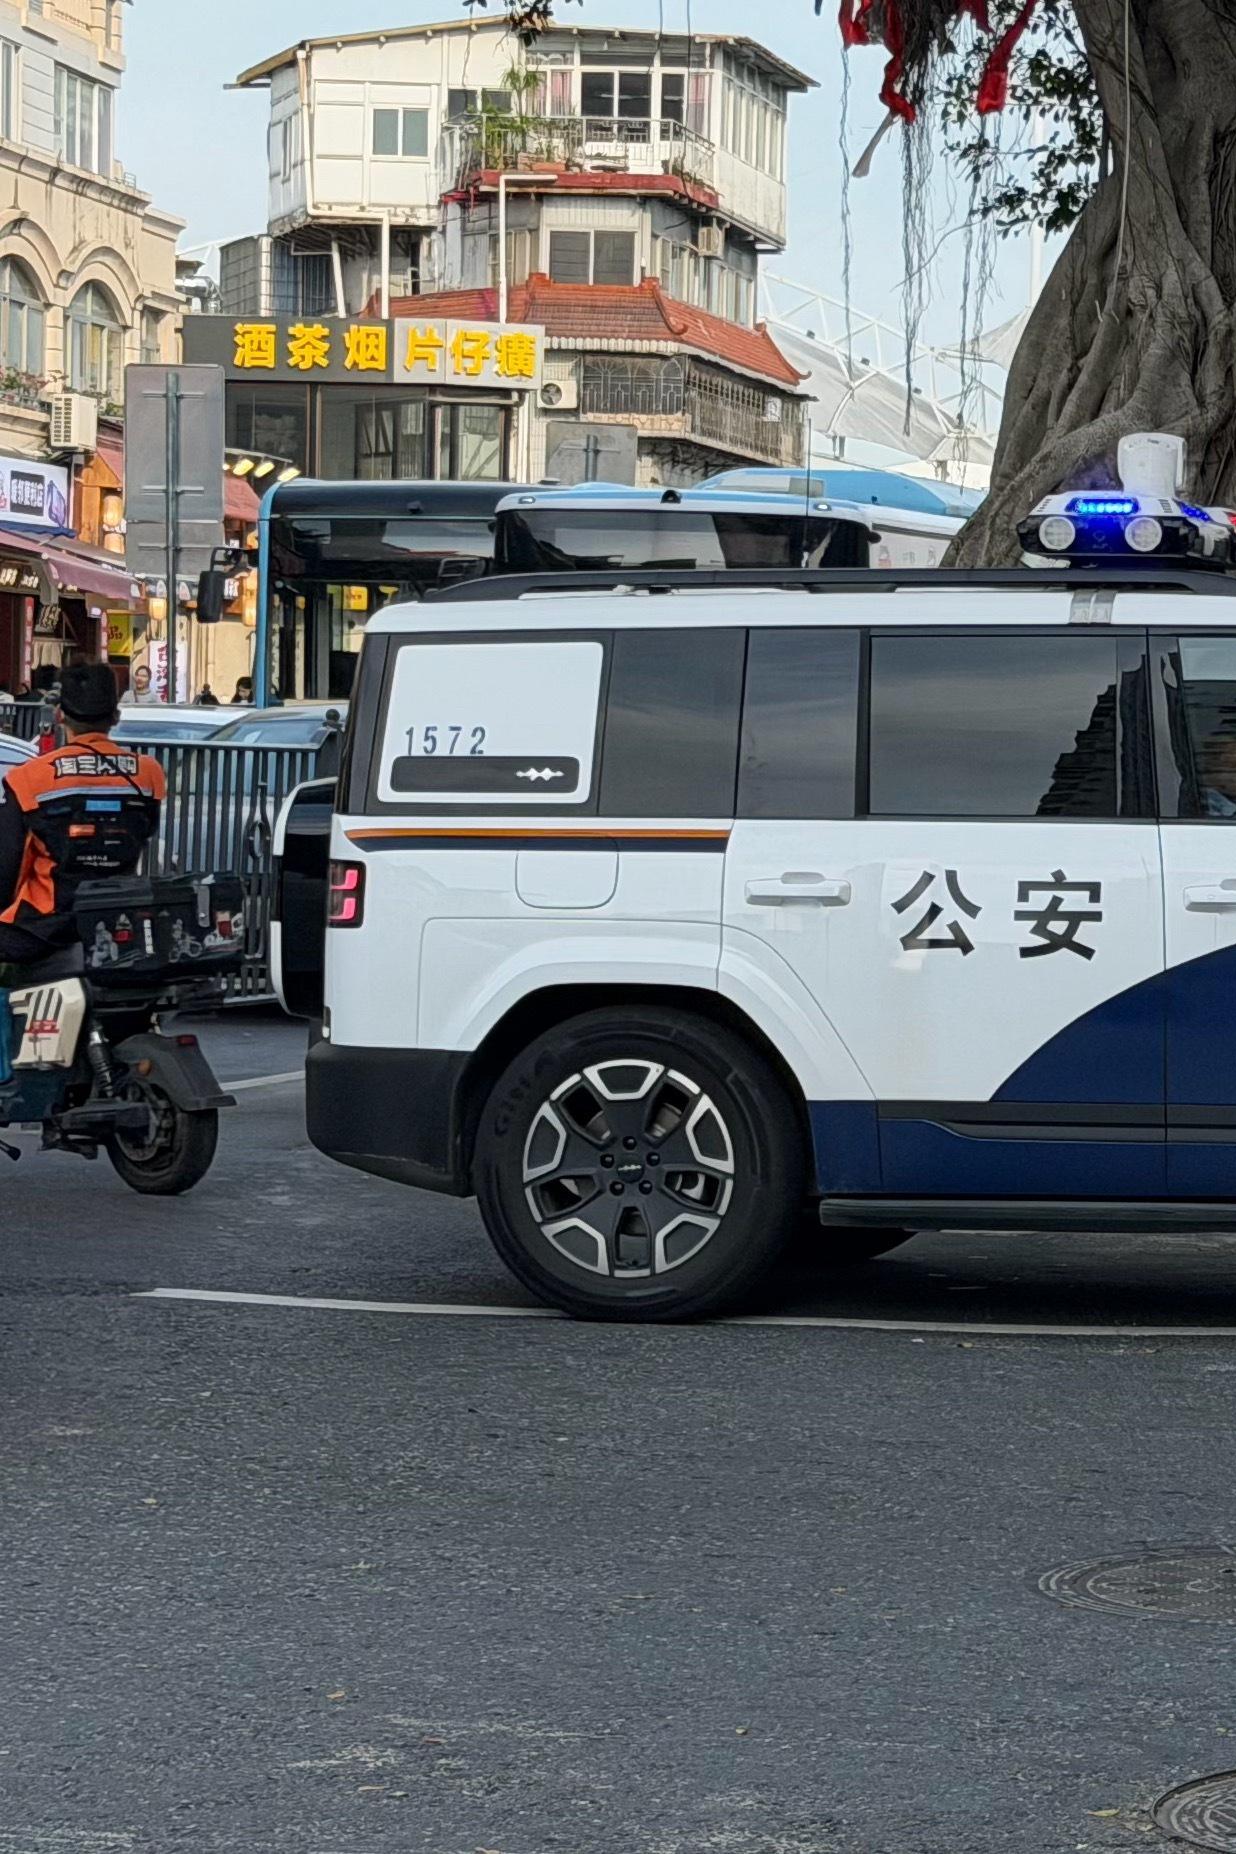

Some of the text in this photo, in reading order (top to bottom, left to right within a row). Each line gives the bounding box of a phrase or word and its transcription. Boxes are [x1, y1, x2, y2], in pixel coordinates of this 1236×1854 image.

[233, 322, 387, 371] 酒茶烟
[404, 726, 487, 757] 1572
[890, 868, 1106, 961] 公安
